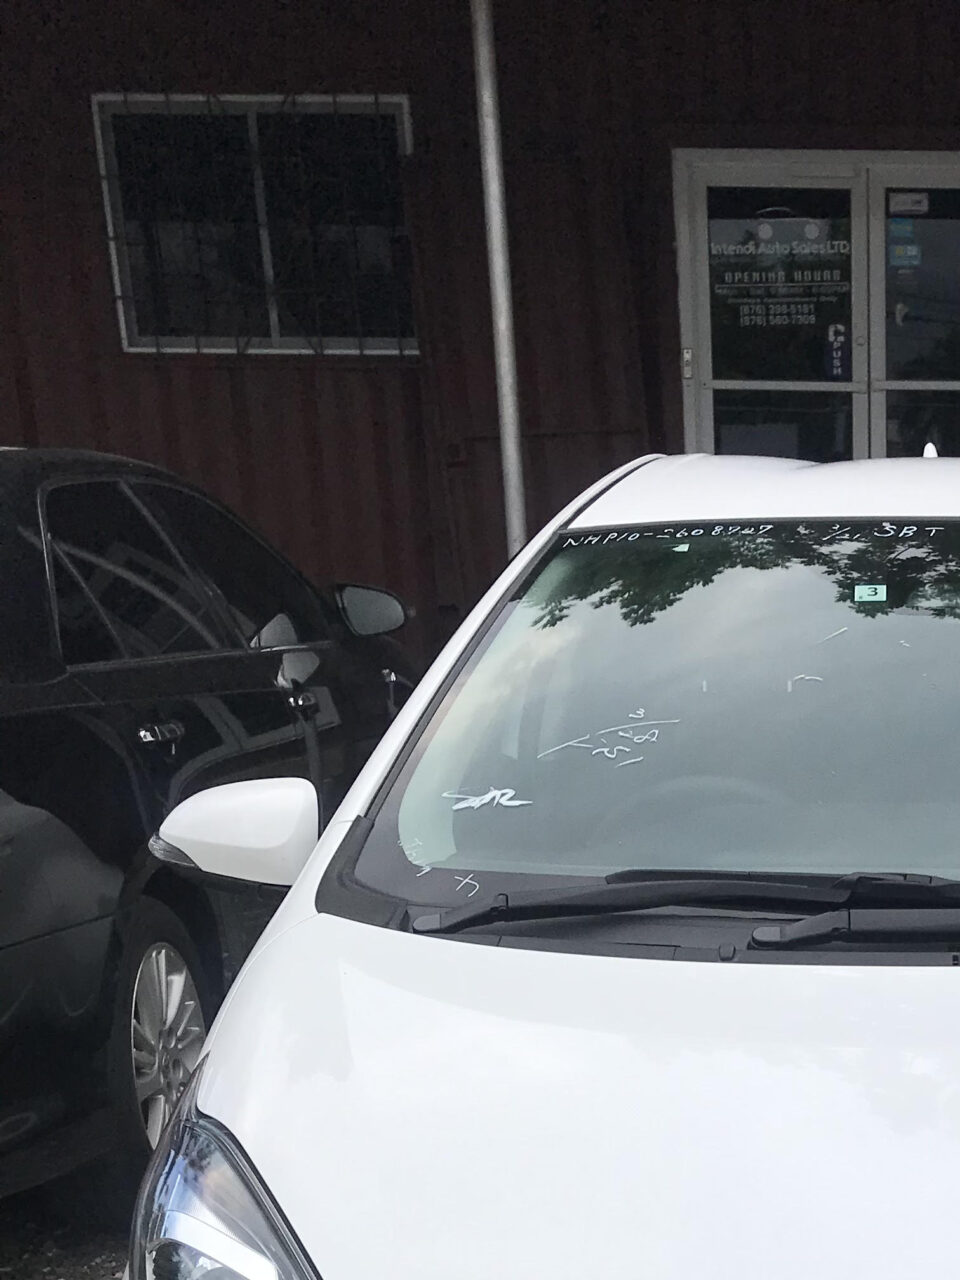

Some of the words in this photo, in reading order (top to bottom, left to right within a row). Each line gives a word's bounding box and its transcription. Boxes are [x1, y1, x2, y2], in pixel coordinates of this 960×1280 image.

[758, 242, 791, 256] Auto
[792, 241, 826, 255] Sales
[867, 586, 878, 597] 3
